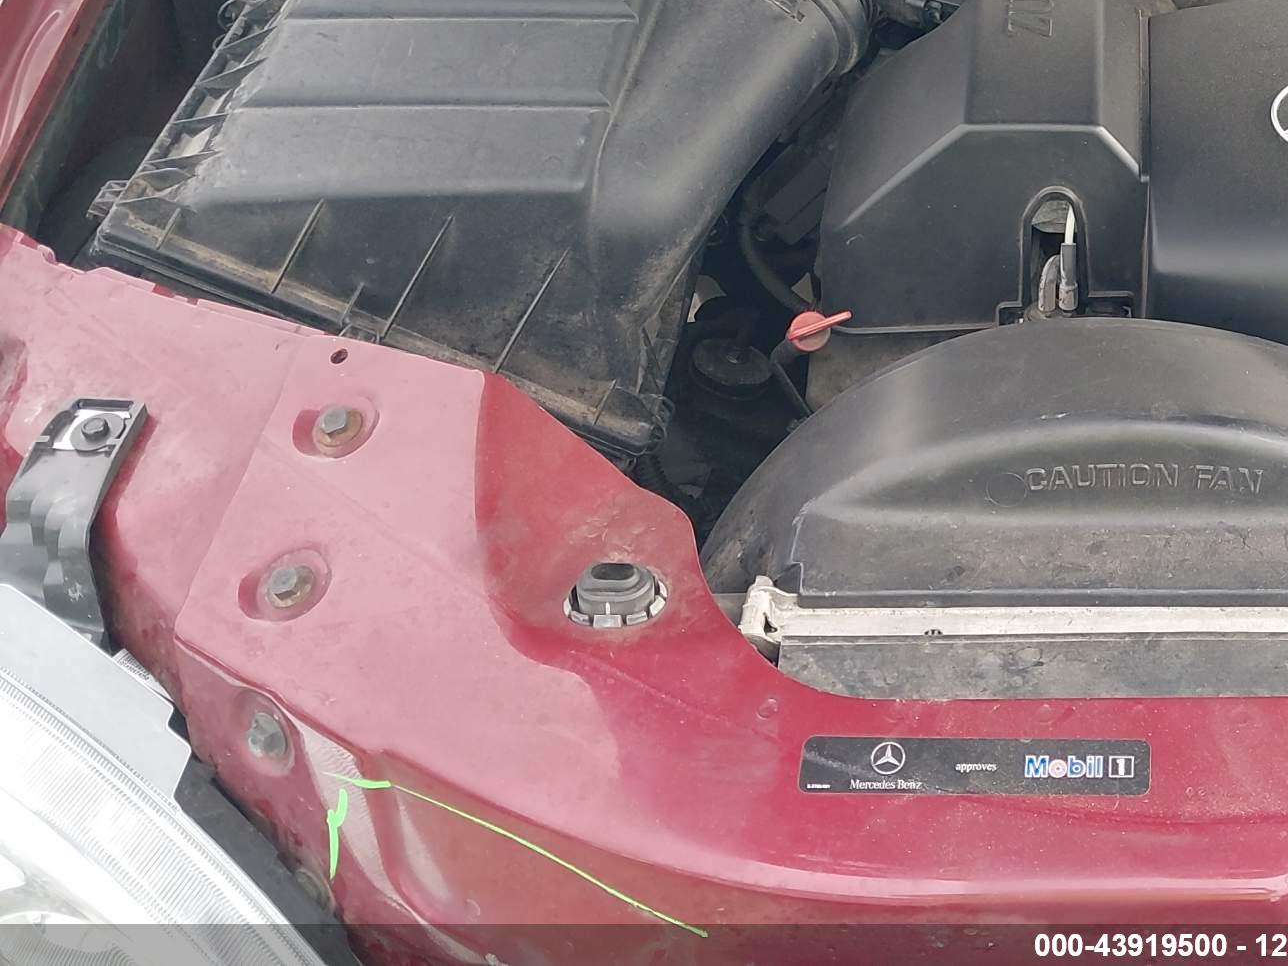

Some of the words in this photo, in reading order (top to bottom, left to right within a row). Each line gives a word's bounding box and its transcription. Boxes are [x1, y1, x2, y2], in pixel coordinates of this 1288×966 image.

[1025, 463, 1179, 491] CAUTION
[1194, 464, 1264, 493] FAN
[955, 763, 997, 773] approves
[1024, 755, 1104, 778] Mobil
[850, 778, 895, 790] Mercedes
[897, 779, 923, 790] Benz
